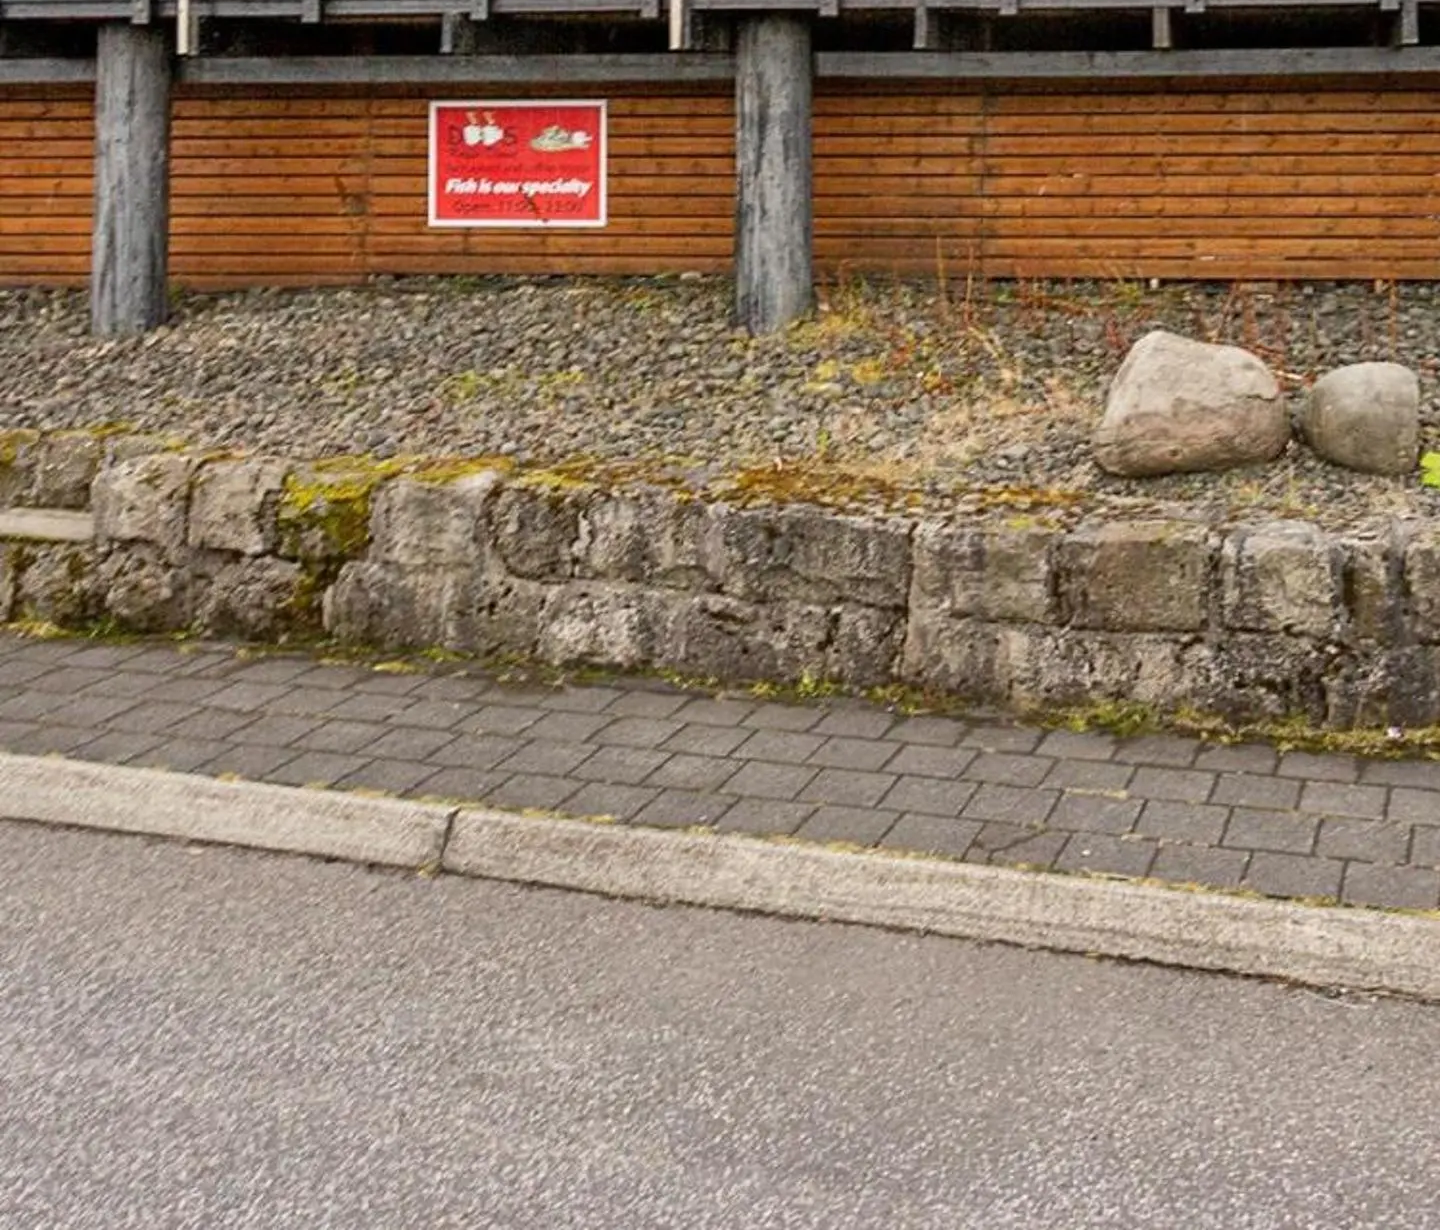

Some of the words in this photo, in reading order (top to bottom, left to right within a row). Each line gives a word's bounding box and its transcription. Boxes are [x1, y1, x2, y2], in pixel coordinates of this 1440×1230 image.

[445, 178, 477, 194] Fish
[477, 178, 492, 194] is
[492, 181, 521, 194] our
[521, 178, 593, 198] specialty
